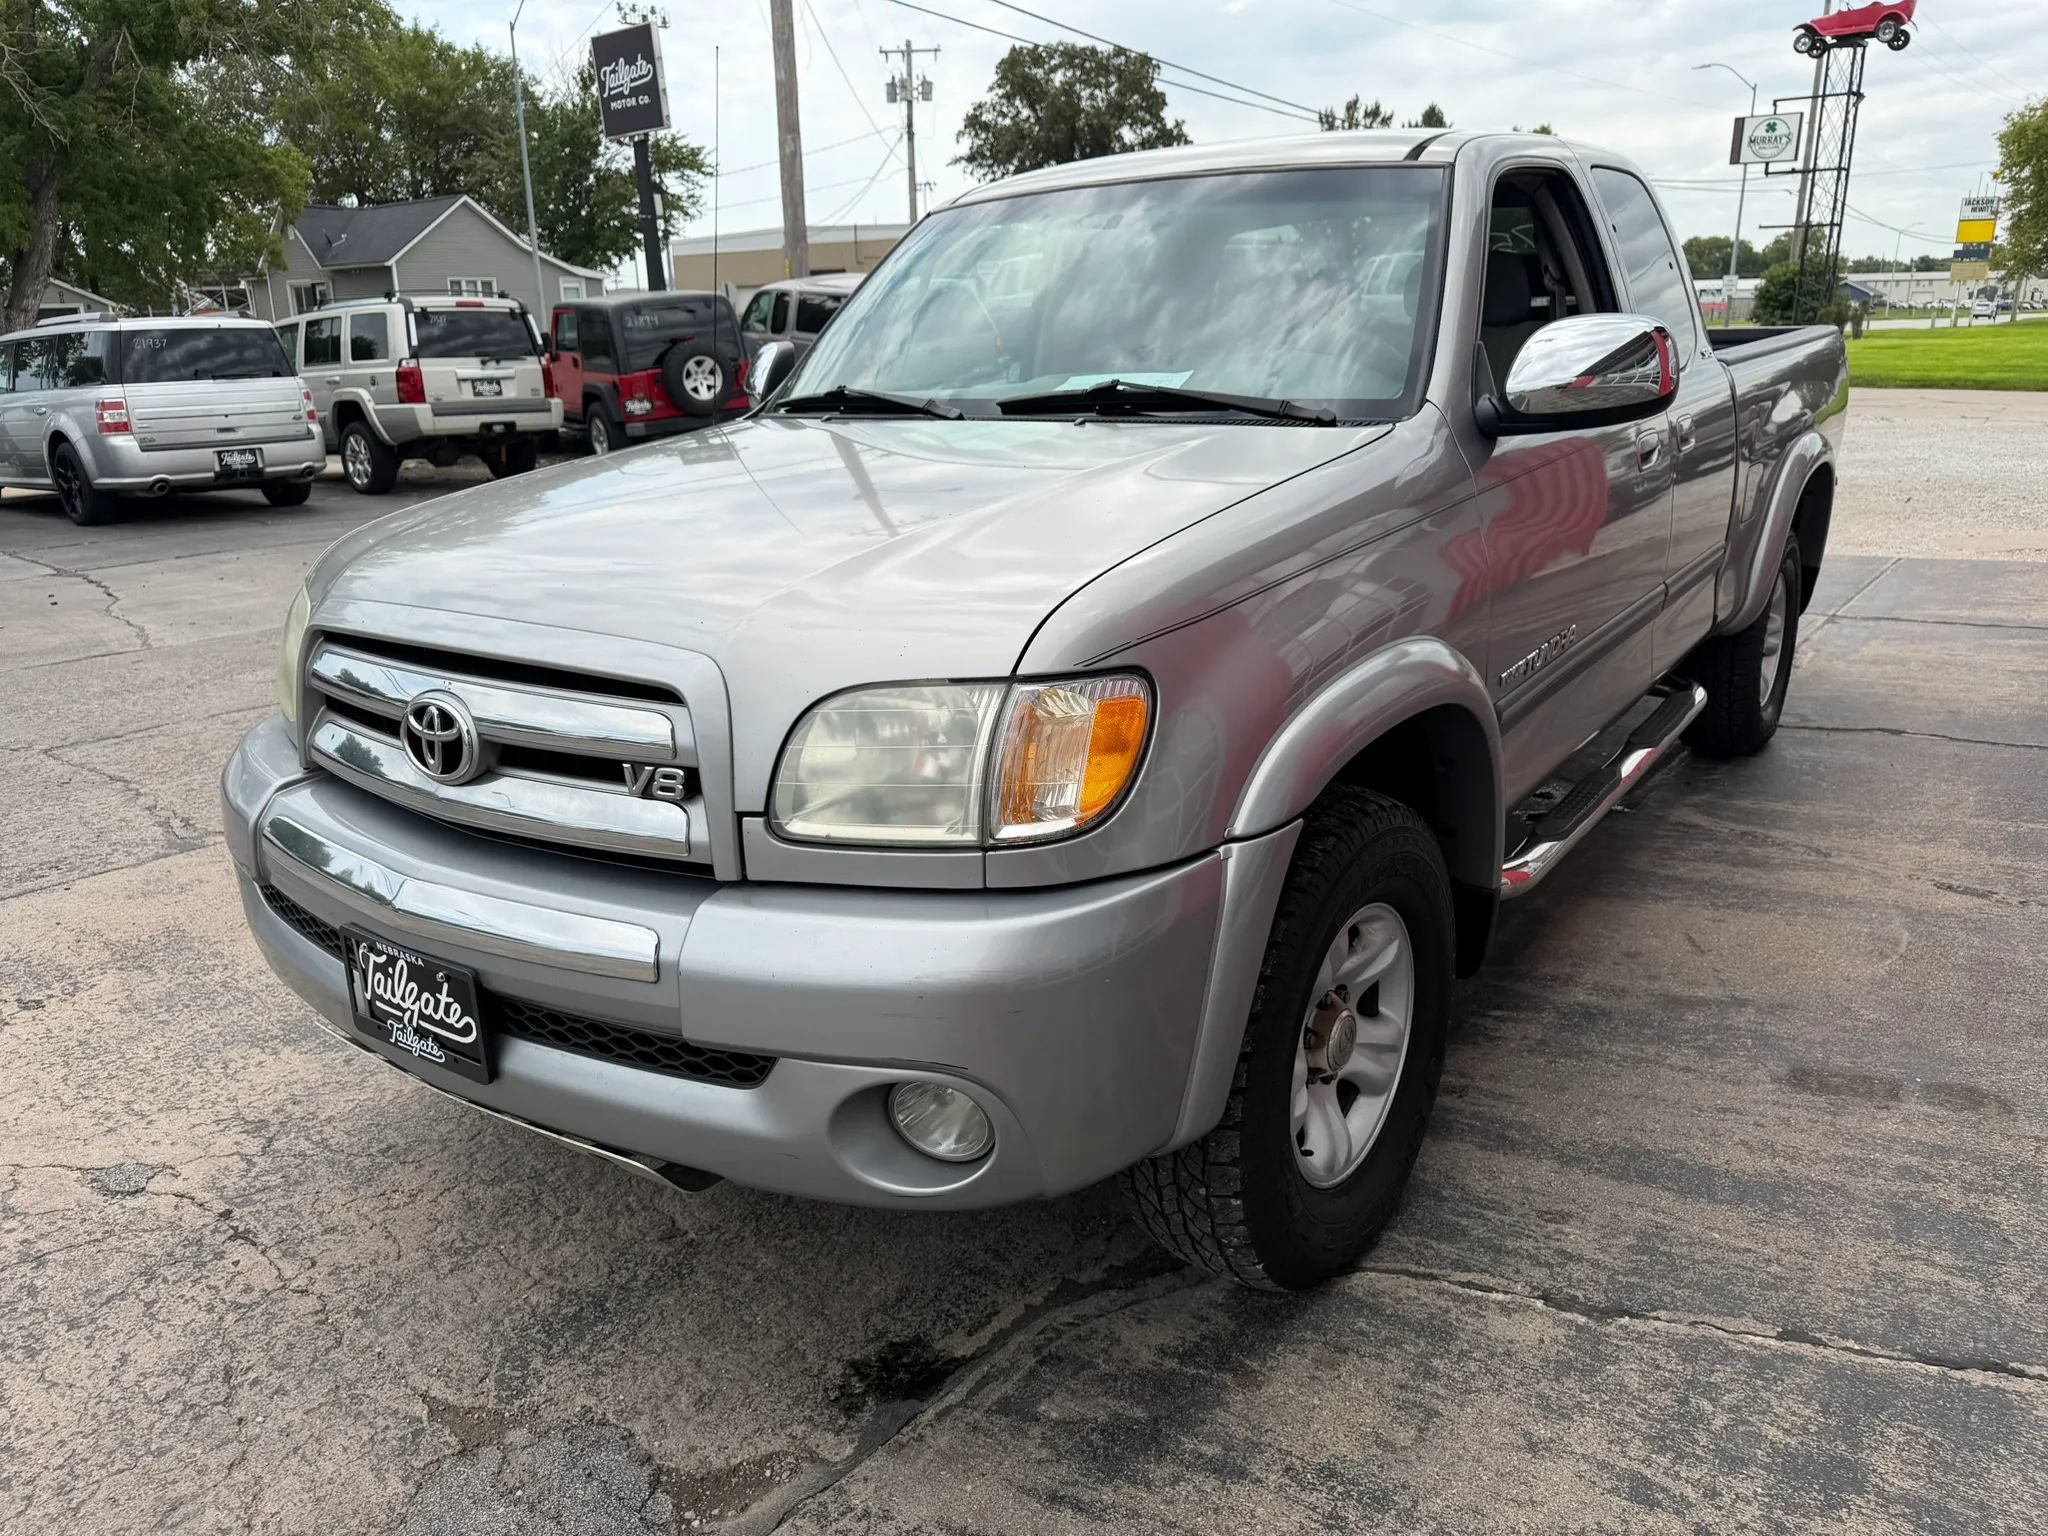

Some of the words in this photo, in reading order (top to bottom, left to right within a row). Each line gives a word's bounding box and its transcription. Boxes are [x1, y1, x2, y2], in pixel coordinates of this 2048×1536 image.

[600, 53, 653, 98] Tailgate
[610, 97, 637, 111] MOTOR
[638, 95, 651, 105] CO.
[1748, 133, 1793, 148] MURRAY'S
[1964, 198, 1995, 206] JACKSON
[132, 336, 167, 349] 21937
[622, 763, 686, 800] V8
[376, 941, 425, 967] NEBRASKA
[358, 942, 478, 1044] Tailgate
[386, 1019, 446, 1063] Tailgate
